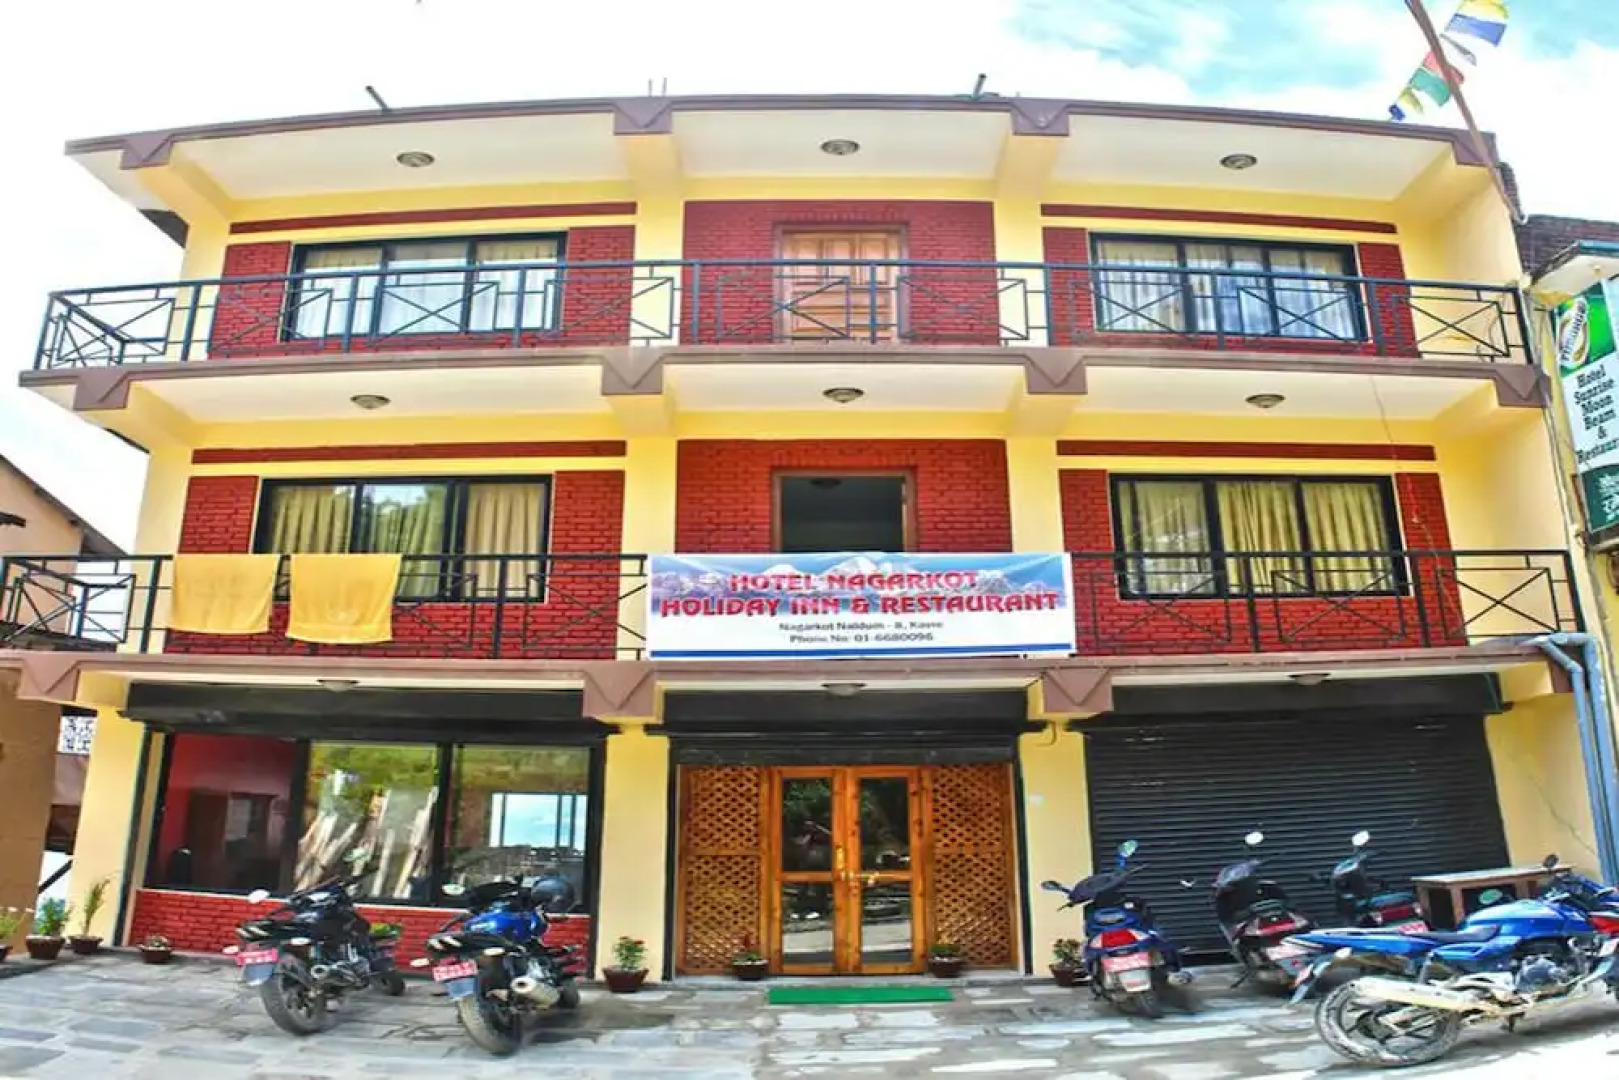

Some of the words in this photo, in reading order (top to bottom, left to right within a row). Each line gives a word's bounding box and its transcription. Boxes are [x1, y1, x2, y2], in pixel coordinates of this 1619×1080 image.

[1577, 364, 1606, 388] Hotel
[1574, 379, 1614, 405] Sunrise
[1581, 395, 1613, 416] Moon
[1584, 408, 1616, 430] Beam
[1598, 426, 1606, 439] &
[729, 573, 814, 591] HOTEL
[826, 571, 978, 590] NAGARKOT
[660, 596, 780, 617] HOLIDAY
[790, 596, 840, 615] INN
[851, 595, 869, 614] &
[880, 593, 1059, 614] RESTAURANT
[779, 622, 834, 632] Nagarkot
[790, 634, 829, 643] Phone
